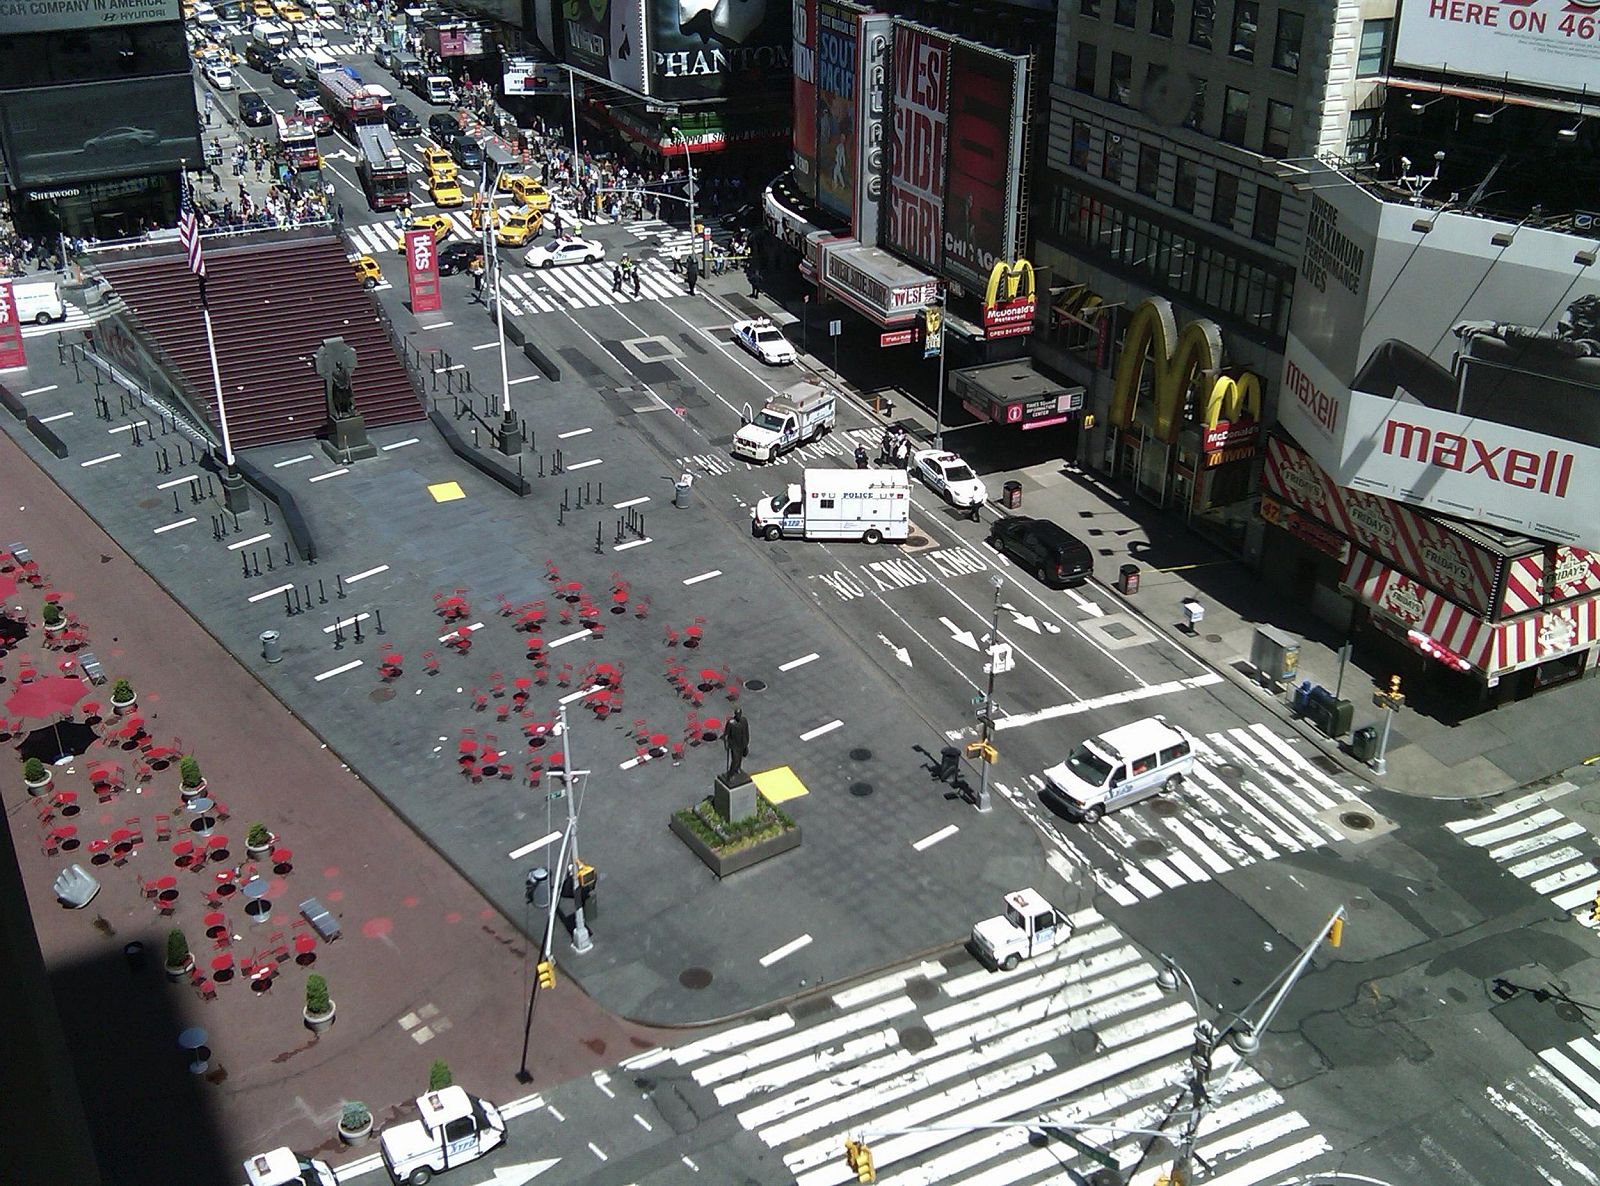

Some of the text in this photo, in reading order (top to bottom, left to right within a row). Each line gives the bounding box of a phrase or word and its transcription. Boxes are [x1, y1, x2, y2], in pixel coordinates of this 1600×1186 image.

[1, 3, 27, 16] CAR
[32, 1, 90, 15] COMPANY
[94, 0, 106, 10] IN
[120, 10, 166, 20] HYUNDAI
[1429, 0, 1500, 28] HERE
[1509, 9, 1548, 34] ON
[869, 34, 886, 199] PALACE
[1311, 191, 1339, 227] WHERE
[413, 234, 432, 270] tkts
[1307, 210, 1365, 276] MAXIMUM
[1301, 253, 1328, 293] LIVES
[987, 305, 1034, 319] McDonald's
[1286, 360, 1339, 433] maxell
[1382, 419, 1574, 498] maxell
[860, 558, 927, 592] ONLY
